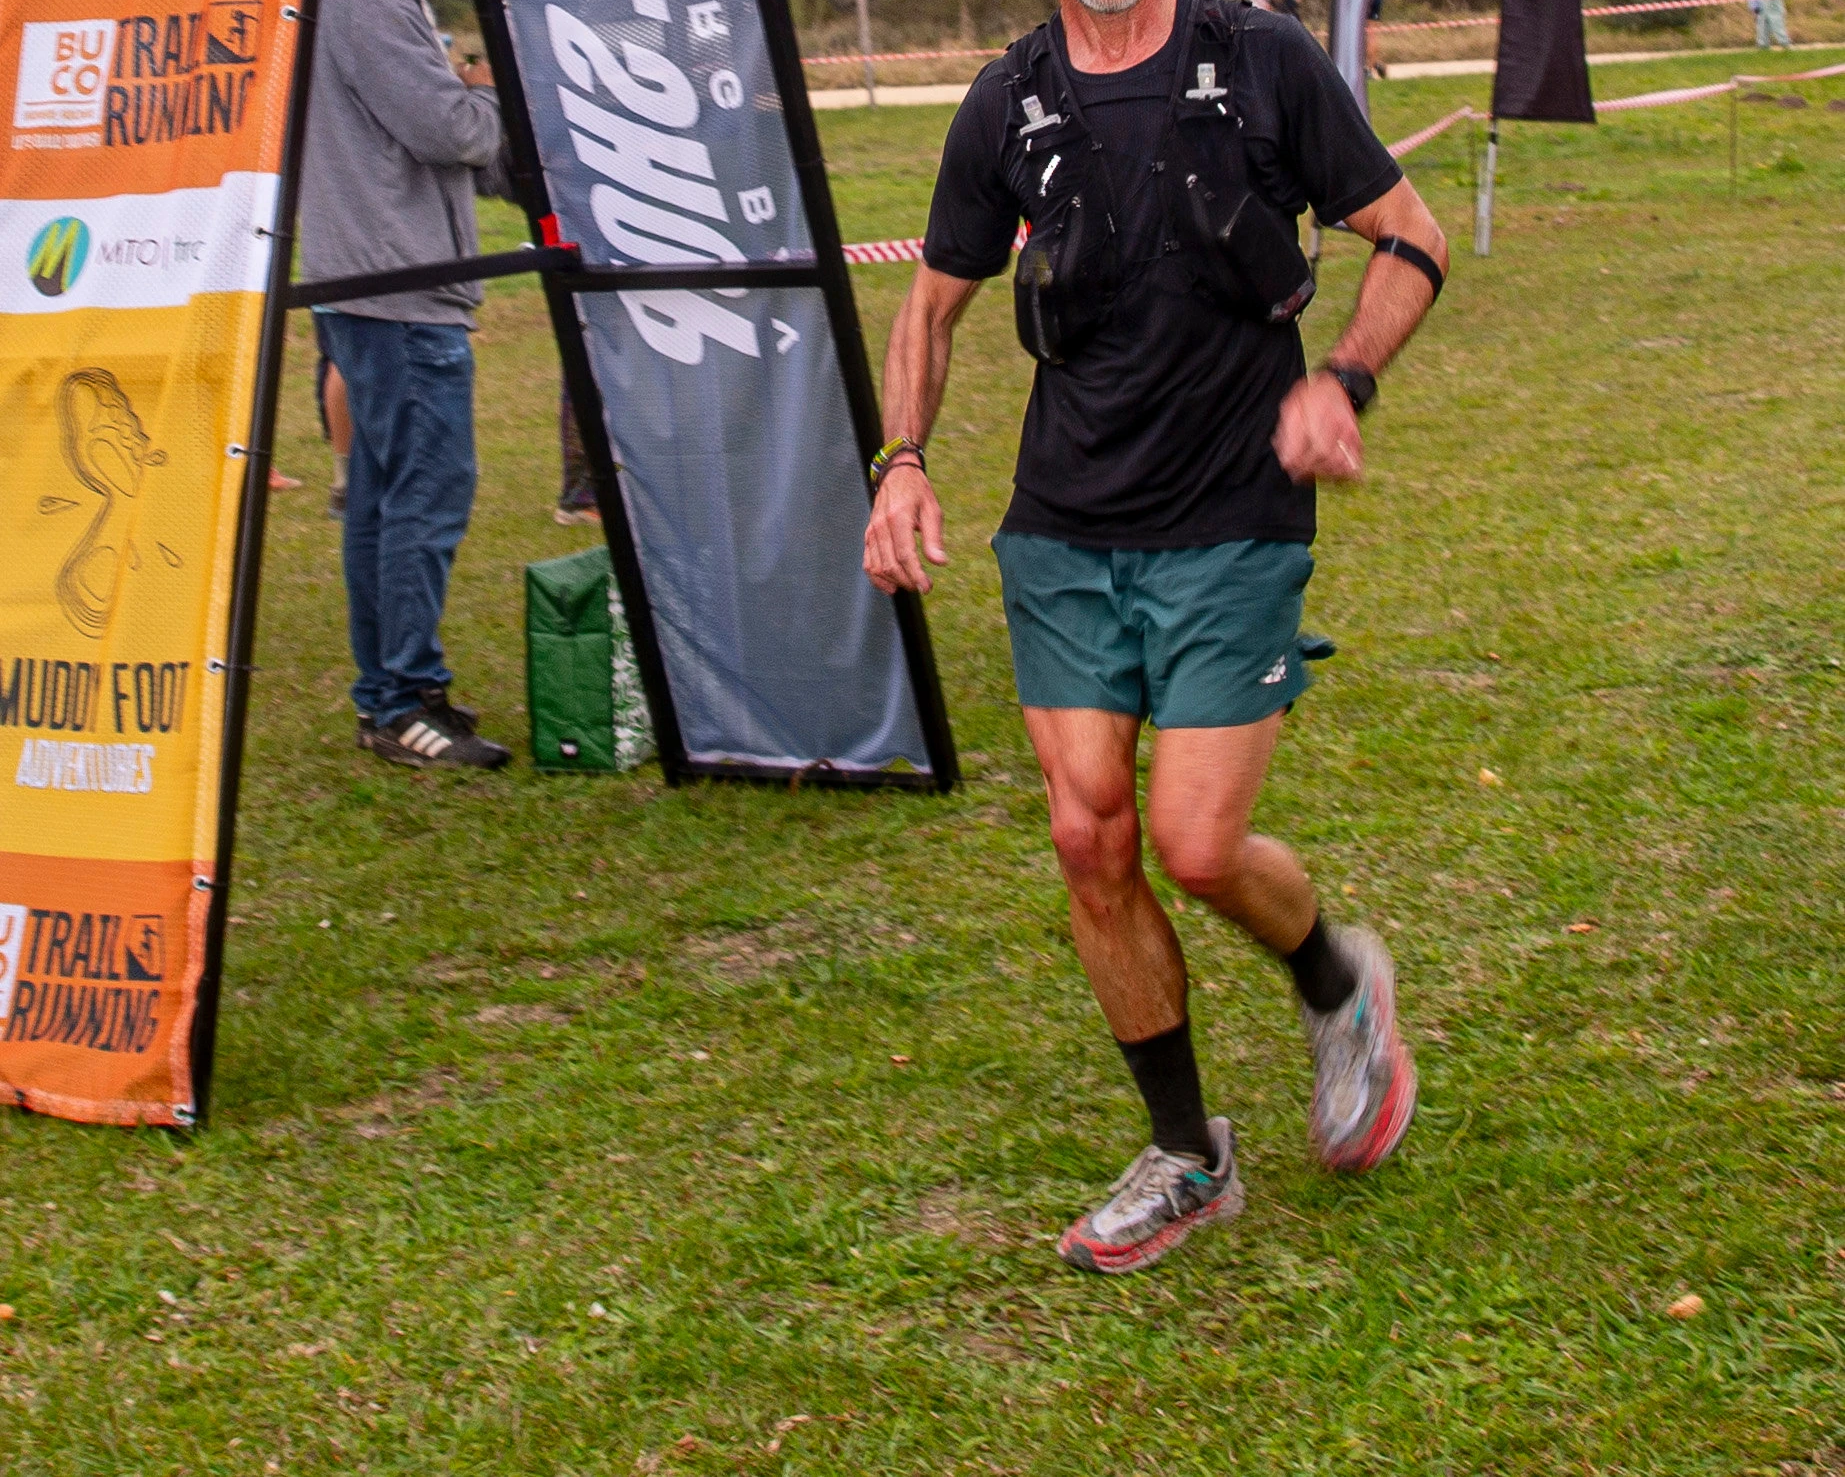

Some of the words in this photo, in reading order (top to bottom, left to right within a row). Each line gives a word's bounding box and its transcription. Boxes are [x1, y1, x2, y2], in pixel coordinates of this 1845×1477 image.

[55, 29, 106, 62] BU
[52, 64, 101, 95] CO
[112, 661, 190, 734] FOOT
[27, 908, 121, 981] TRAIL
